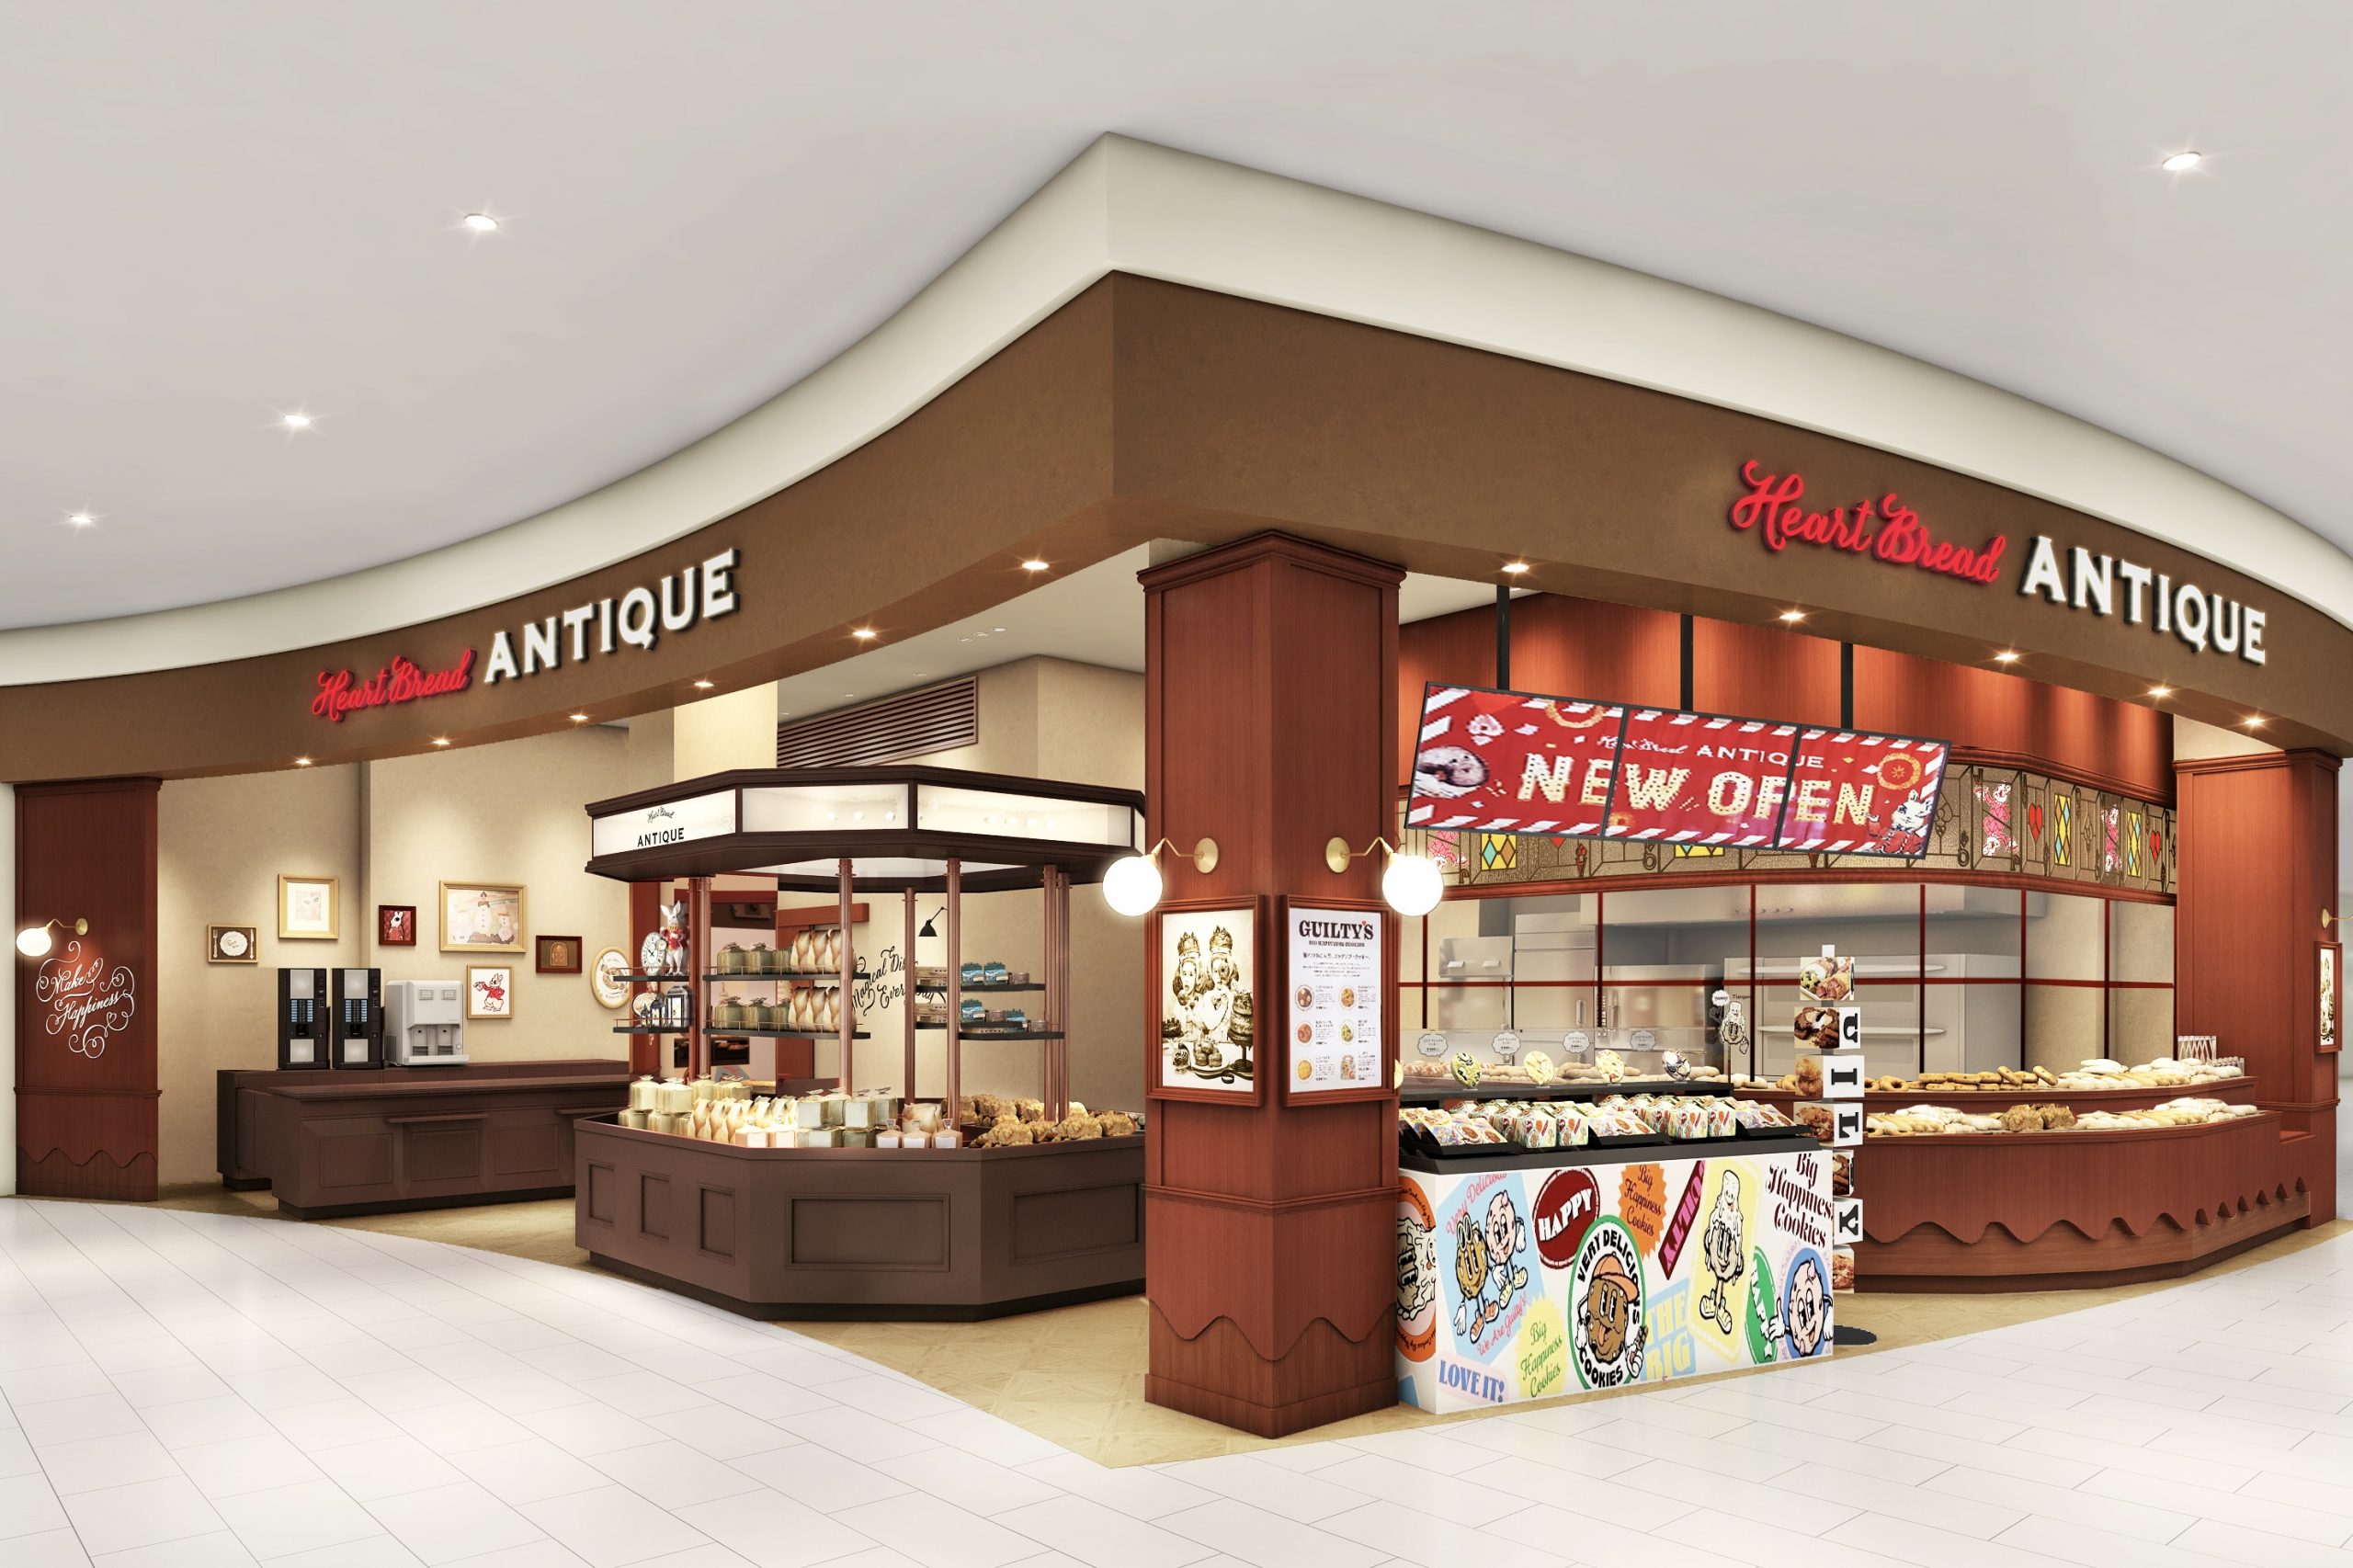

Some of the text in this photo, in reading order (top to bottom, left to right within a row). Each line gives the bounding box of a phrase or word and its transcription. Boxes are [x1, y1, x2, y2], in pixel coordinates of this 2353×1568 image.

[1727, 459, 2267, 665] Heart Bread ANTIQUE
[312, 548, 740, 722] Heart Bread ANTIQUE
[1696, 744, 1824, 769] ANTIQUE
[1517, 752, 1875, 827] NEW OPEN
[637, 826, 685, 847] ANTIQUE
[1299, 919, 1374, 940] GUILTY'S
[1638, 1164, 1654, 1192] Big
[1766, 1164, 1834, 1221] Happines
[1796, 1153, 1819, 1189] Big
[1538, 1187, 1593, 1242] HAPPY
[1624, 1177, 1663, 1216] Happiness
[1626, 1207, 1655, 1237] Cookies
[1773, 1202, 1826, 1248] Cookies
[1577, 1233, 1600, 1283] VERY
[1529, 1320, 1548, 1346] Big
[1520, 1335, 1563, 1381] Happiness
[1579, 1346, 1624, 1389] COOKIES
[1438, 1359, 1506, 1403] LOVE IT!
[1529, 1363, 1562, 1398] Cookies
